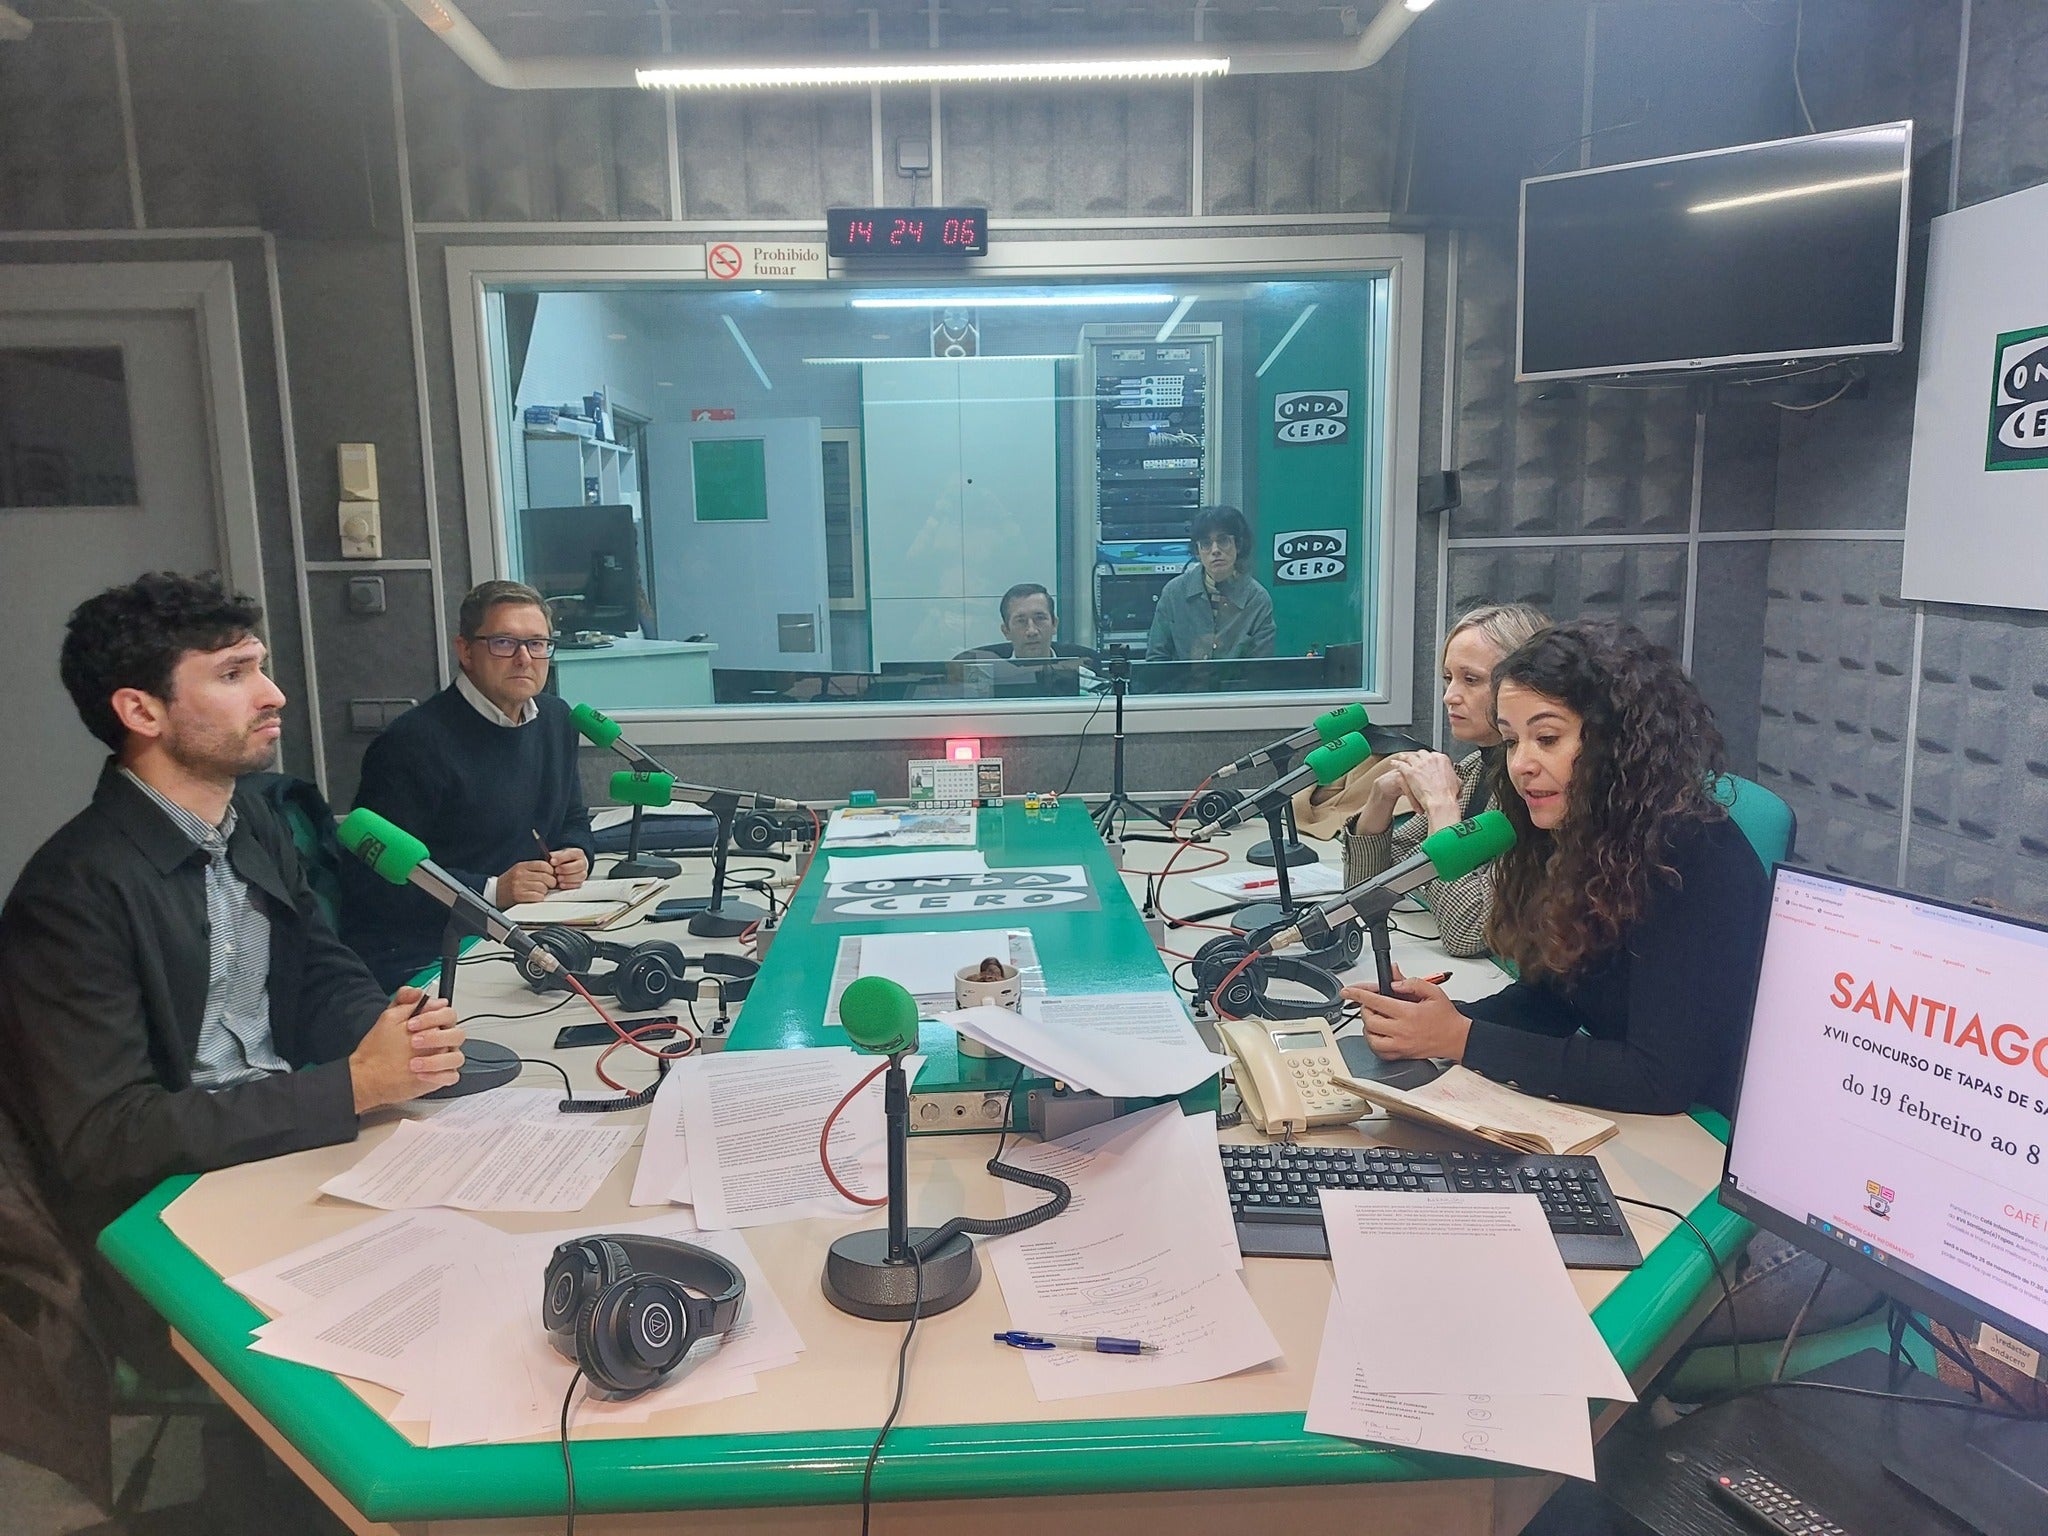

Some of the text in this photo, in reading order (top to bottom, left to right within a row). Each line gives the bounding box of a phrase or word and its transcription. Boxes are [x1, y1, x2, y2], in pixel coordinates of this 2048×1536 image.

[849, 219, 976, 245] 14 24 06
[754, 247, 820, 262] Prohibido
[754, 262, 797, 276] fumar
[1284, 402, 1338, 415] ONDA
[1287, 423, 1337, 437] CERO
[1283, 541, 1336, 554] ONDA
[1286, 562, 1336, 575] CERO
[865, 875, 1050, 891] ONDA
[870, 893, 1054, 910] CERO
[1823, 1025, 1849, 1044] XVII
[1852, 1035, 1929, 1072] CONCURSO
[1934, 1064, 1953, 1081] DE
[1957, 1072, 2004, 1099] TAPAS
[2007, 1090, 2029, 1109] DE
[1842, 1074, 2041, 1165] do 19 febreiro ao 8
[2003, 1204, 2041, 1229] CAFÉ
[1990, 1346, 2026, 1368] ondacero
